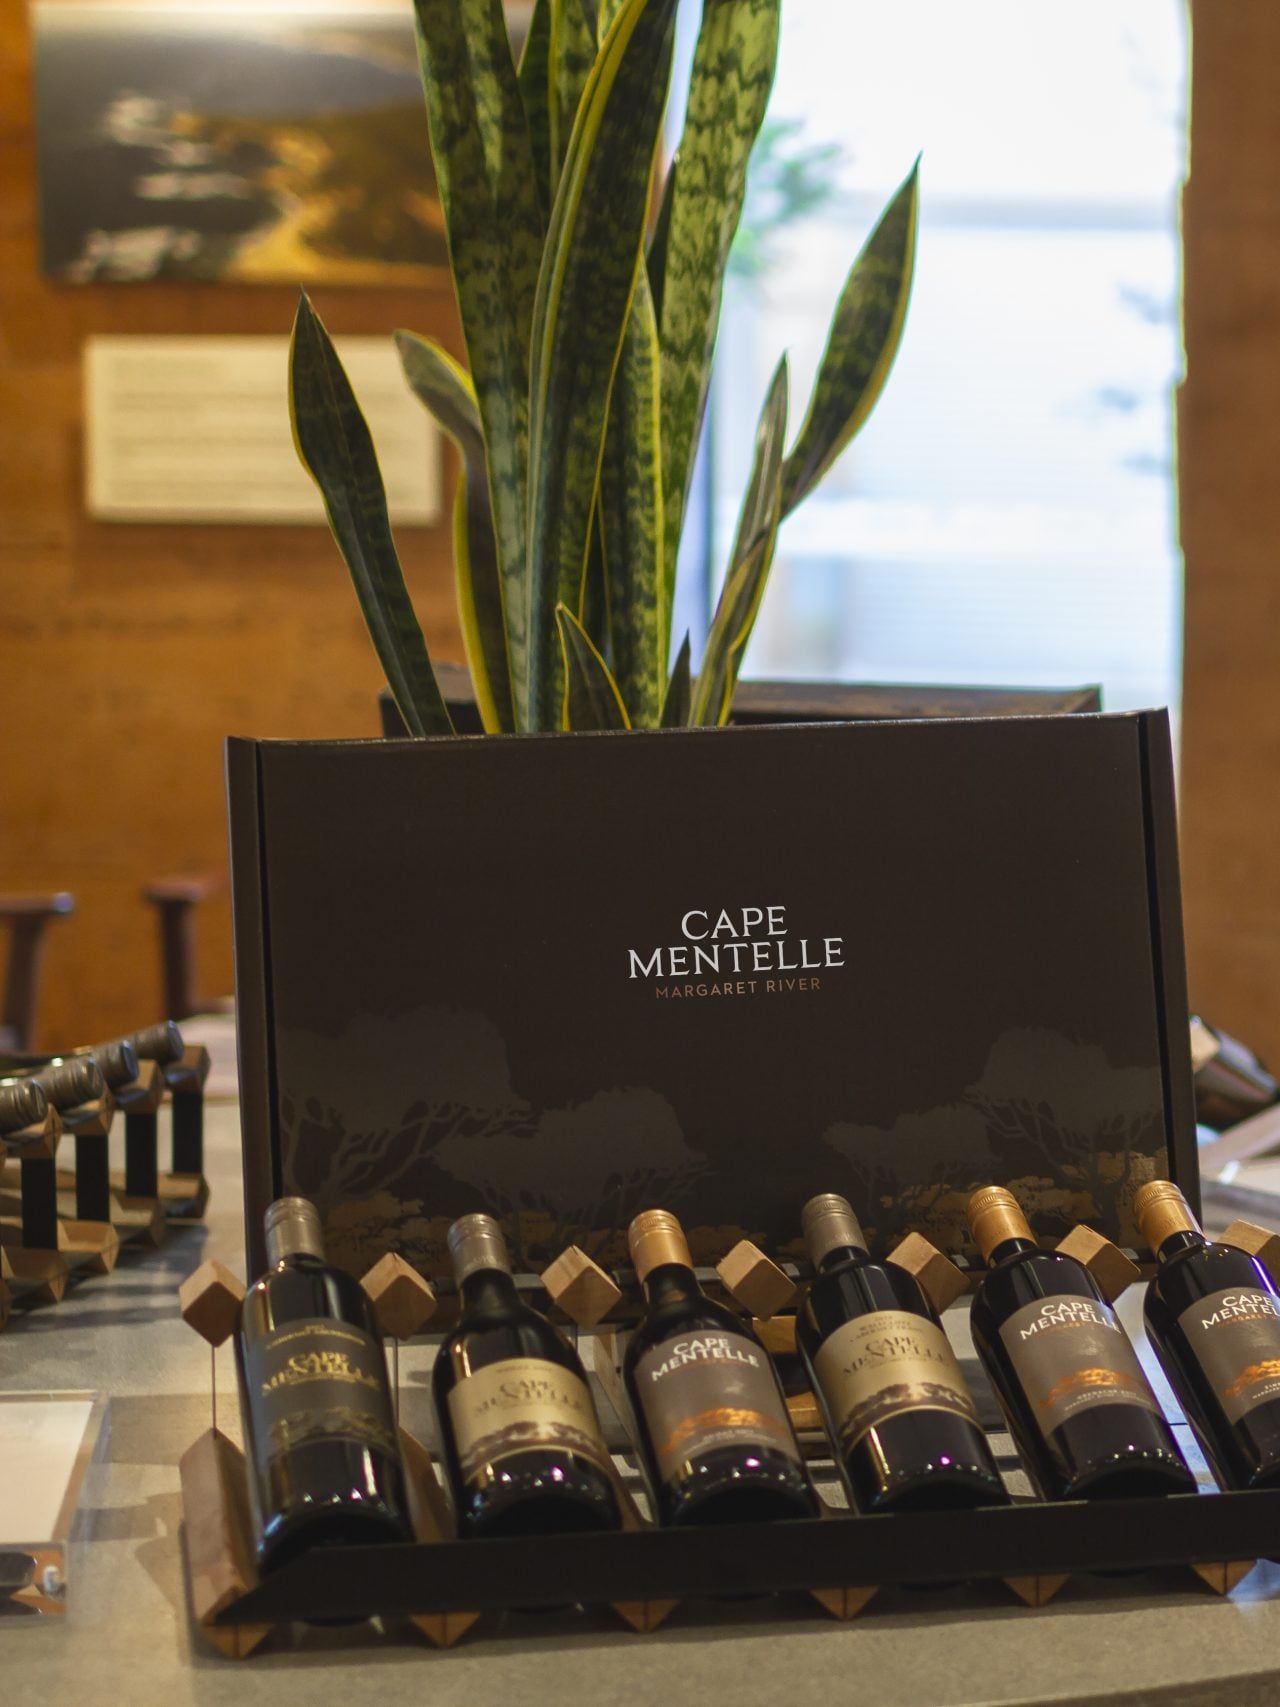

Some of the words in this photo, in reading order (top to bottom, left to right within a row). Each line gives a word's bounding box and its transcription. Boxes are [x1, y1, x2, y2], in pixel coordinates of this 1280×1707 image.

[681, 905, 788, 940] CAPE
[628, 937, 845, 978] MENTELLE
[656, 980, 758, 999] MARGARET
[766, 977, 821, 993] RIVER
[1041, 1302, 1095, 1317] CAPE
[1222, 1294, 1275, 1307] CAPE
[673, 1337, 732, 1355] CAPE
[865, 1335, 917, 1356] CAPE
[650, 1347, 760, 1382] MENTELLE
